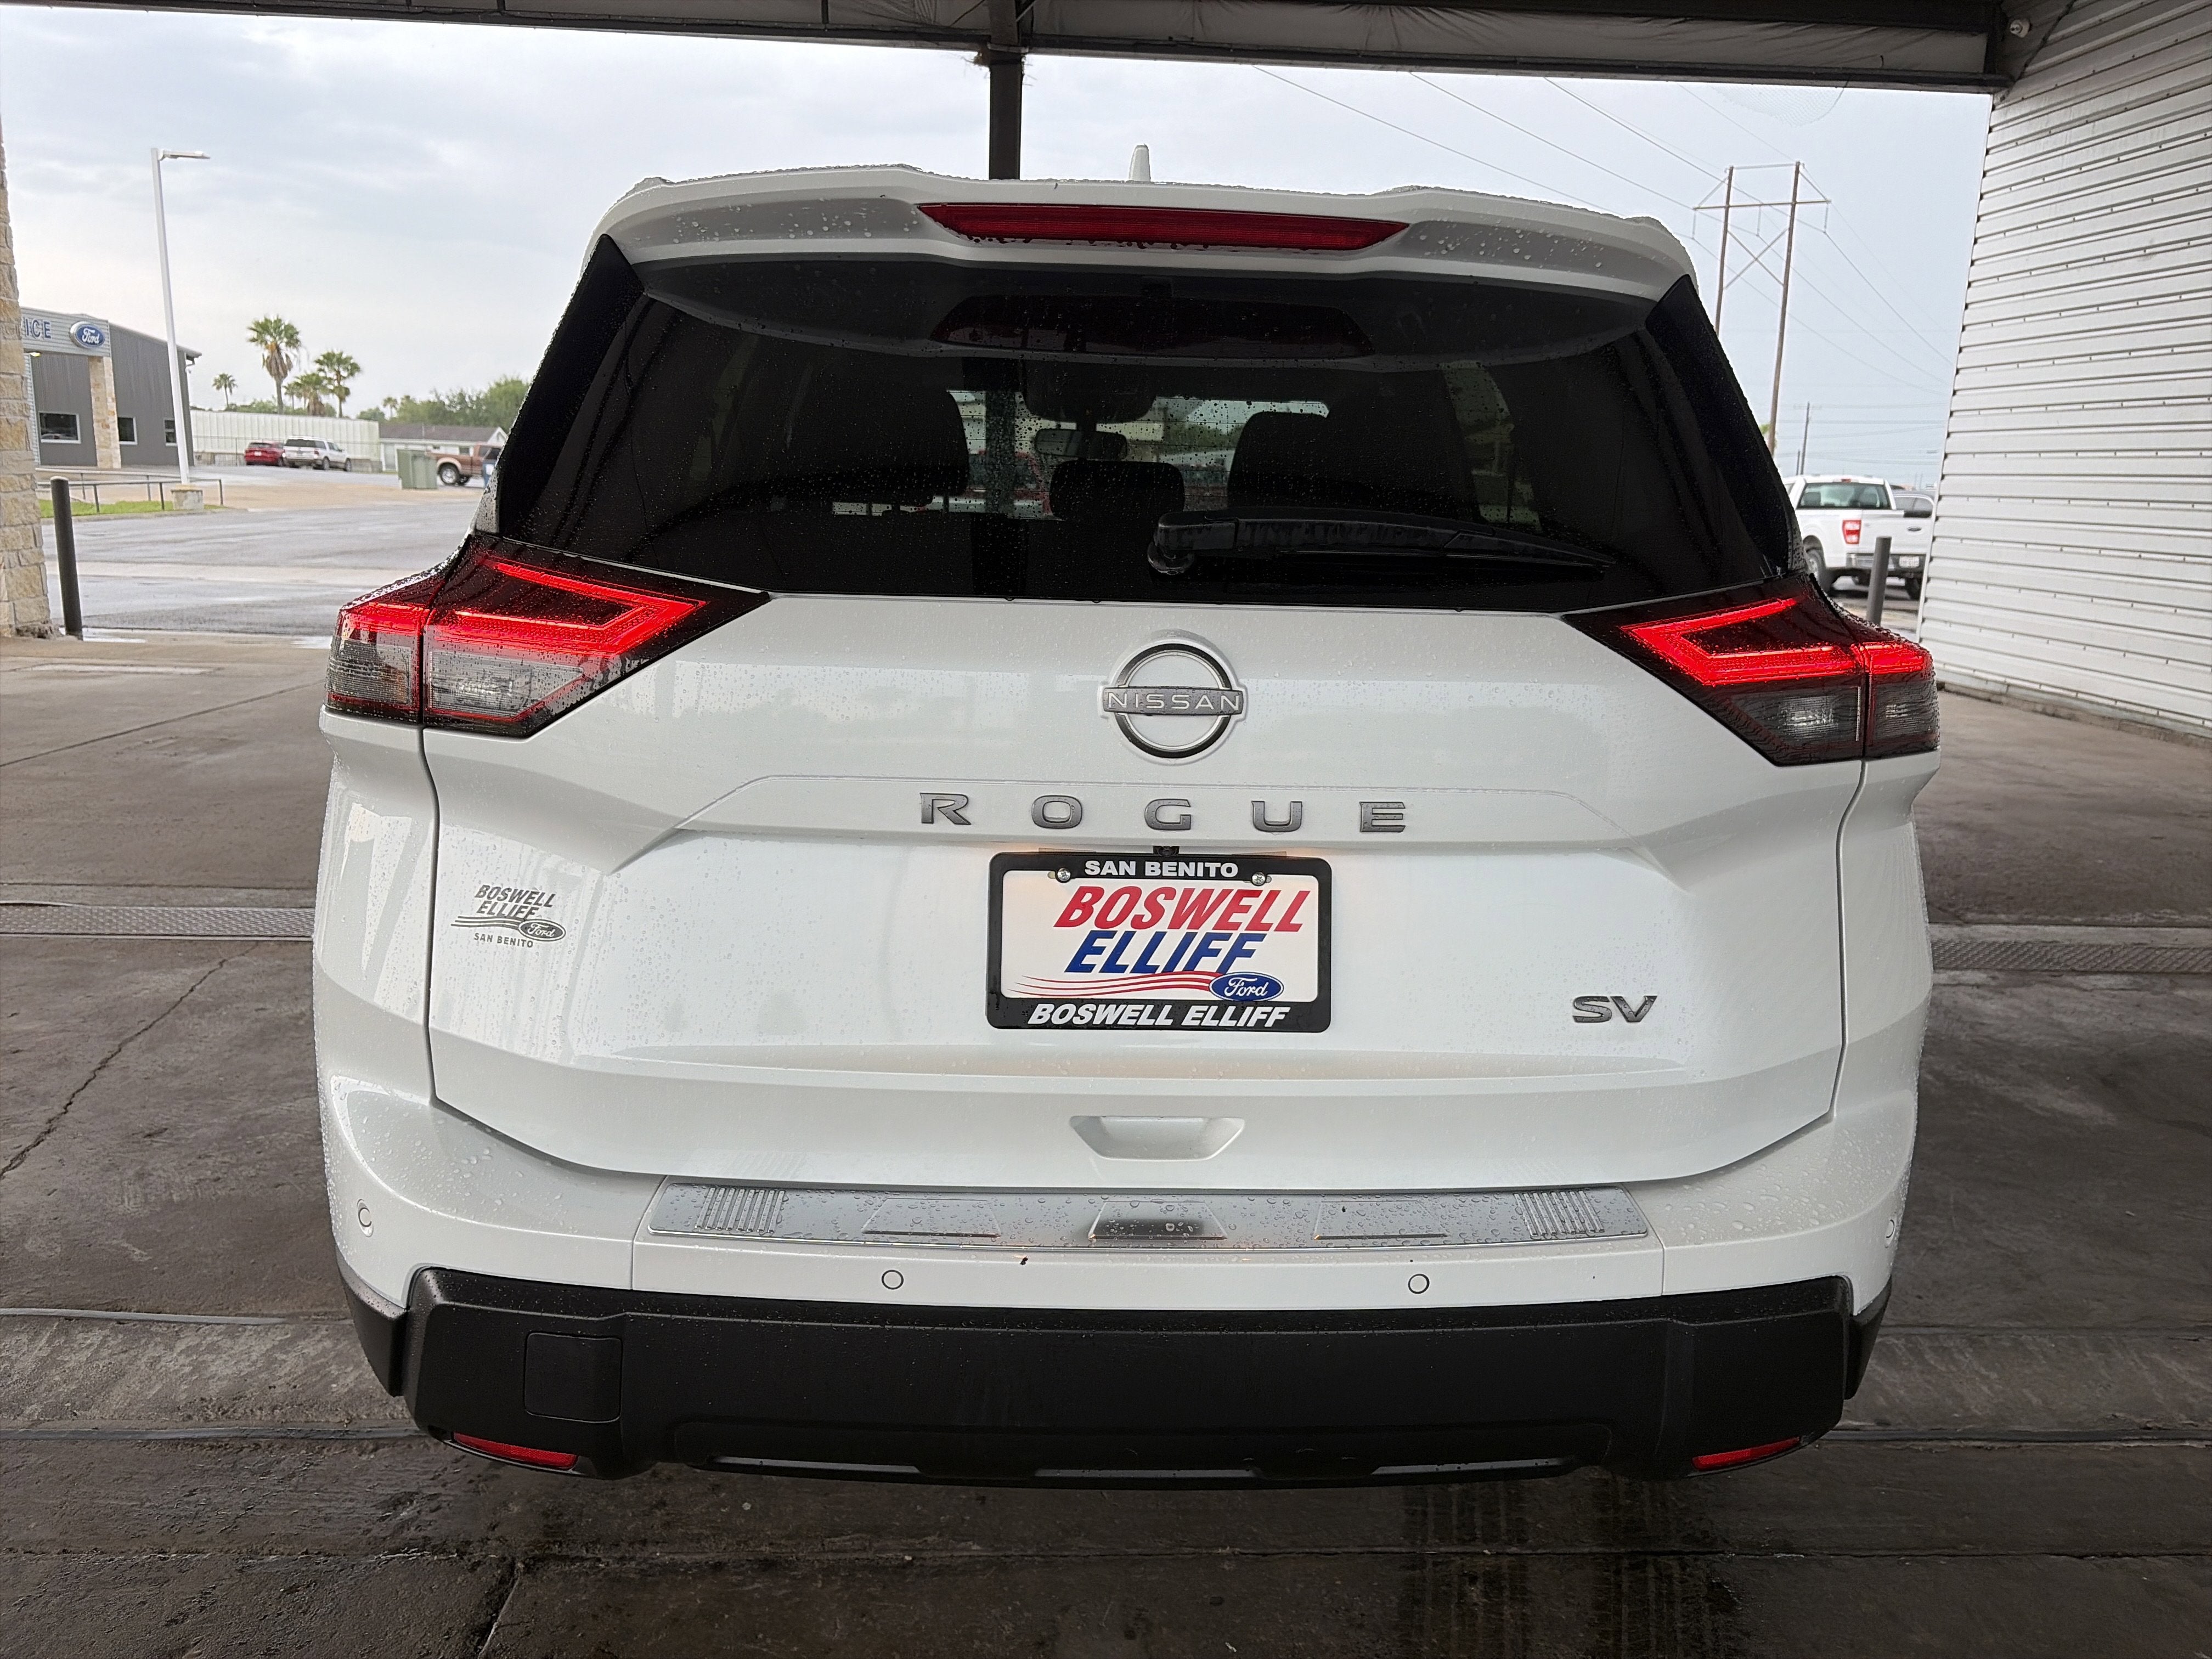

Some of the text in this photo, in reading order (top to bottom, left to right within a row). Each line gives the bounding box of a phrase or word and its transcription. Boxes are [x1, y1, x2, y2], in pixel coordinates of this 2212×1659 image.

[82, 328, 99, 343] Ford
[1108, 692, 1239, 710] NISSAN
[919, 792, 1406, 833] ROGUE
[1085, 860, 1238, 877] SAN BENITO
[475, 884, 556, 907] BOSWELL
[476, 900, 539, 919] ELLIFF
[1054, 885, 1311, 932] BOSWELL
[474, 933, 533, 948] SAN BENITO
[527, 923, 555, 937] Ford
[1064, 930, 1267, 974] ELLIFF
[1224, 976, 1269, 997] Ford
[1028, 1002, 1290, 1027] BOSWELL ELLIFF
[1572, 995, 1658, 1023] SV
